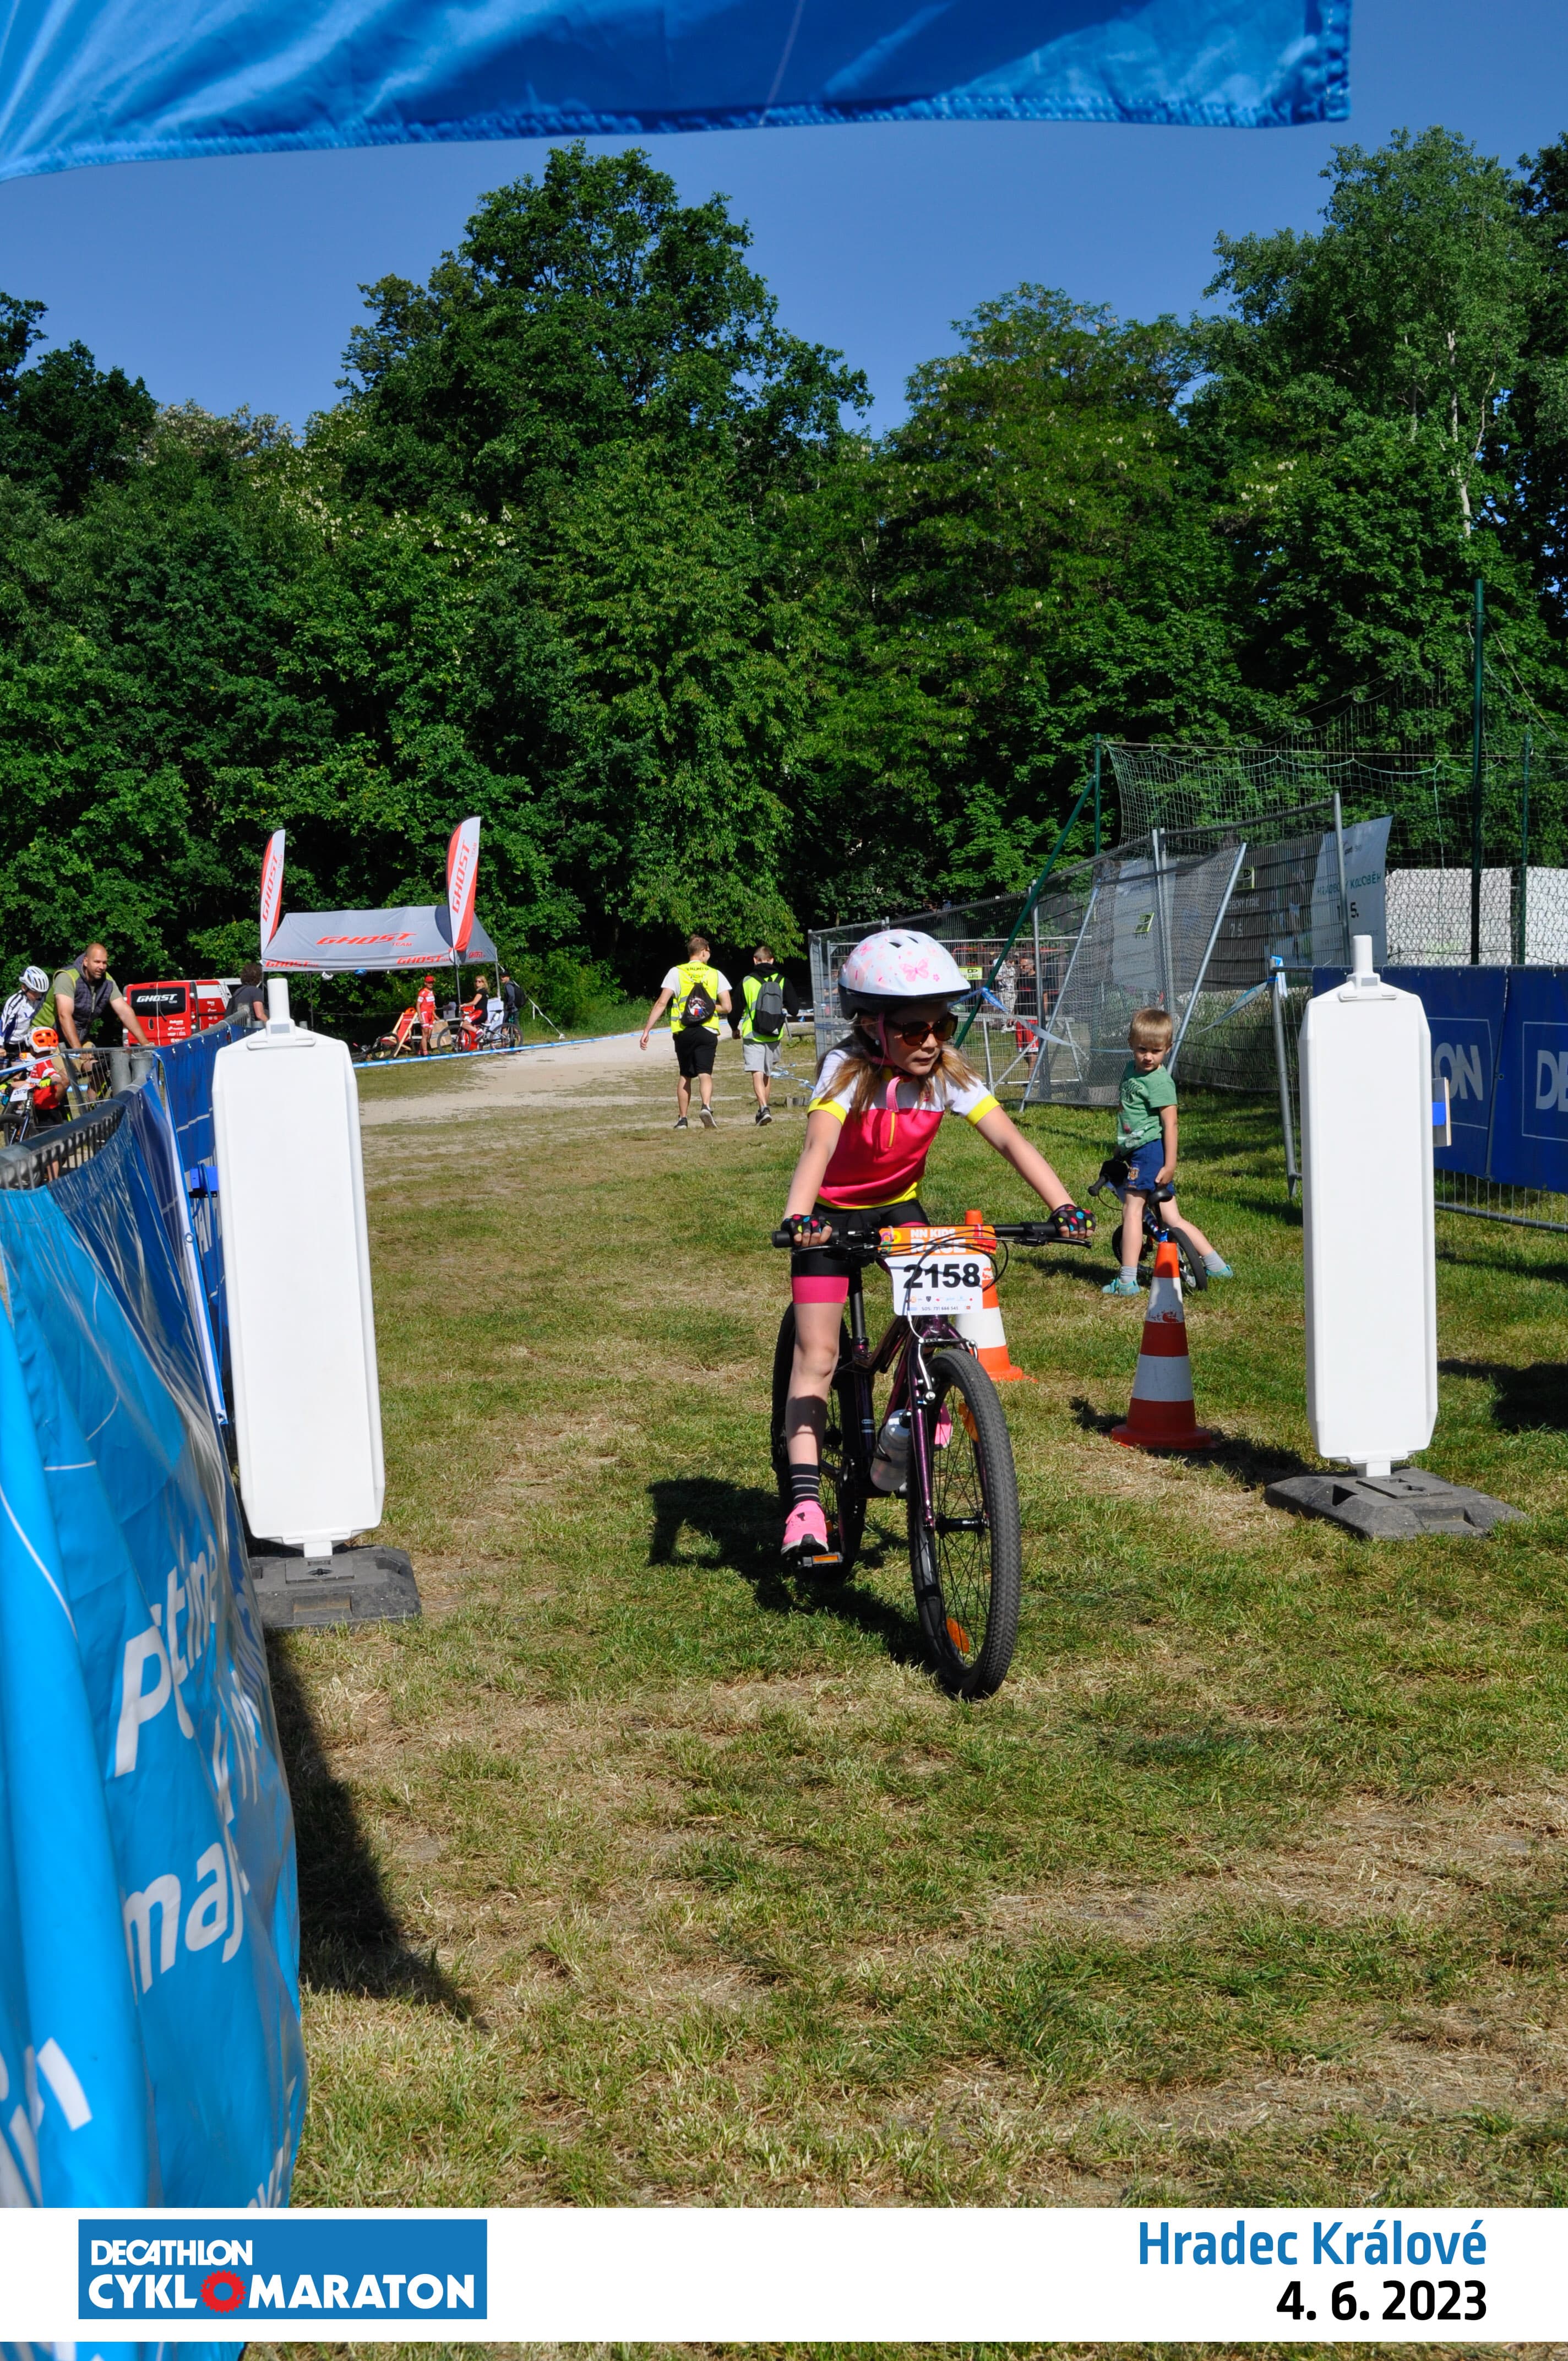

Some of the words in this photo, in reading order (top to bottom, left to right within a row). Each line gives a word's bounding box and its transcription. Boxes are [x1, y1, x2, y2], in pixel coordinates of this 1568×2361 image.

[452, 839, 470, 913] GHOST
[262, 850, 278, 922] GHOST
[316, 932, 417, 945] GHOST
[265, 960, 308, 968] GHOST
[396, 955, 442, 964] GHOST
[136, 993, 178, 1003] GHOST
[910, 1228, 928, 1238] NN
[903, 1263, 981, 1289] 2158
